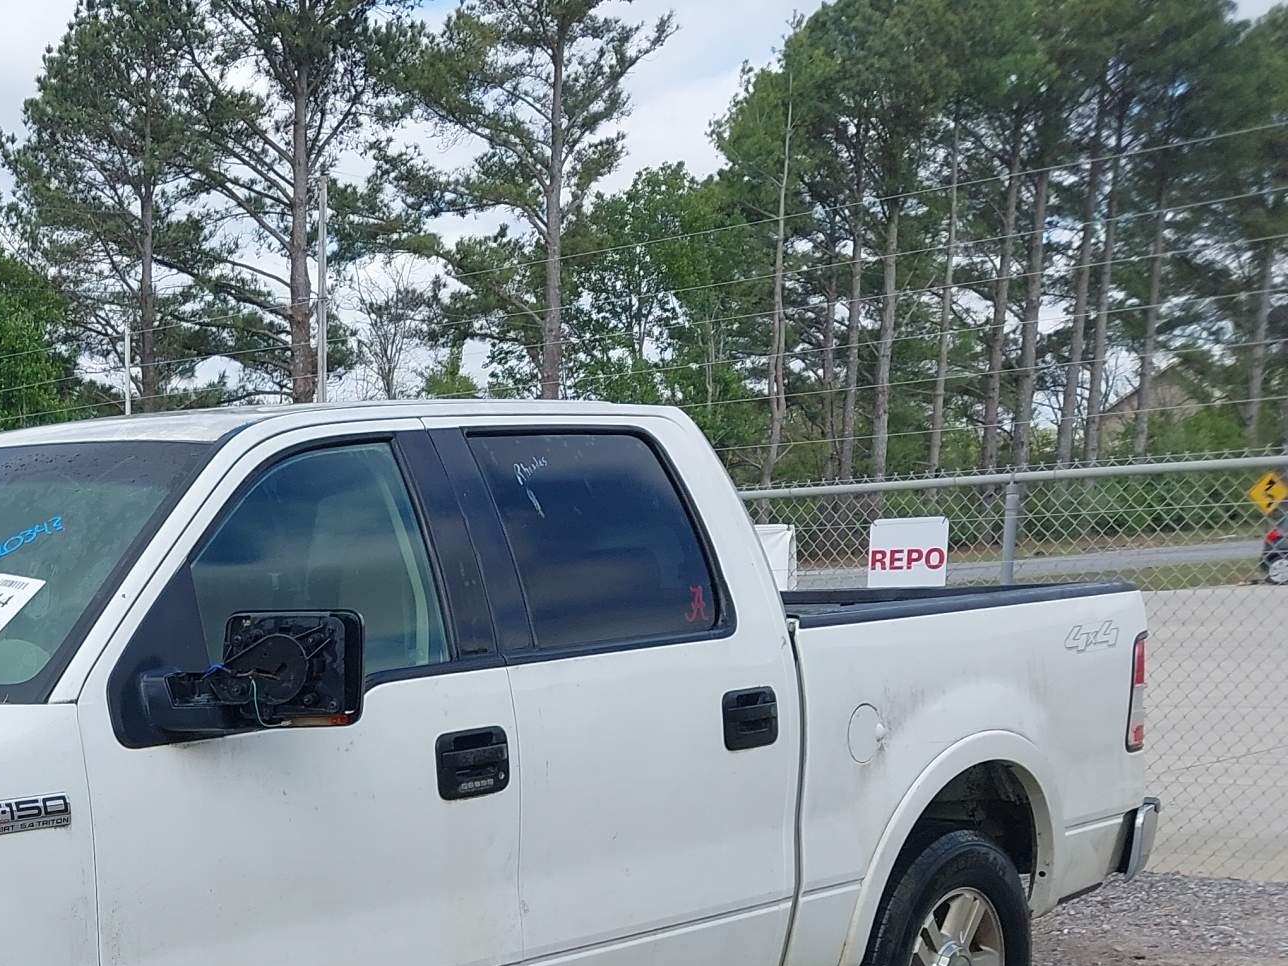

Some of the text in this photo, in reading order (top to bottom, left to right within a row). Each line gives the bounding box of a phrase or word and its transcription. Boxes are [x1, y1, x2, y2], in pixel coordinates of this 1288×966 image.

[870, 547, 945, 571] REPO
[1063, 619, 1120, 652] 4x4
[36, 816, 69, 827] TRITON
